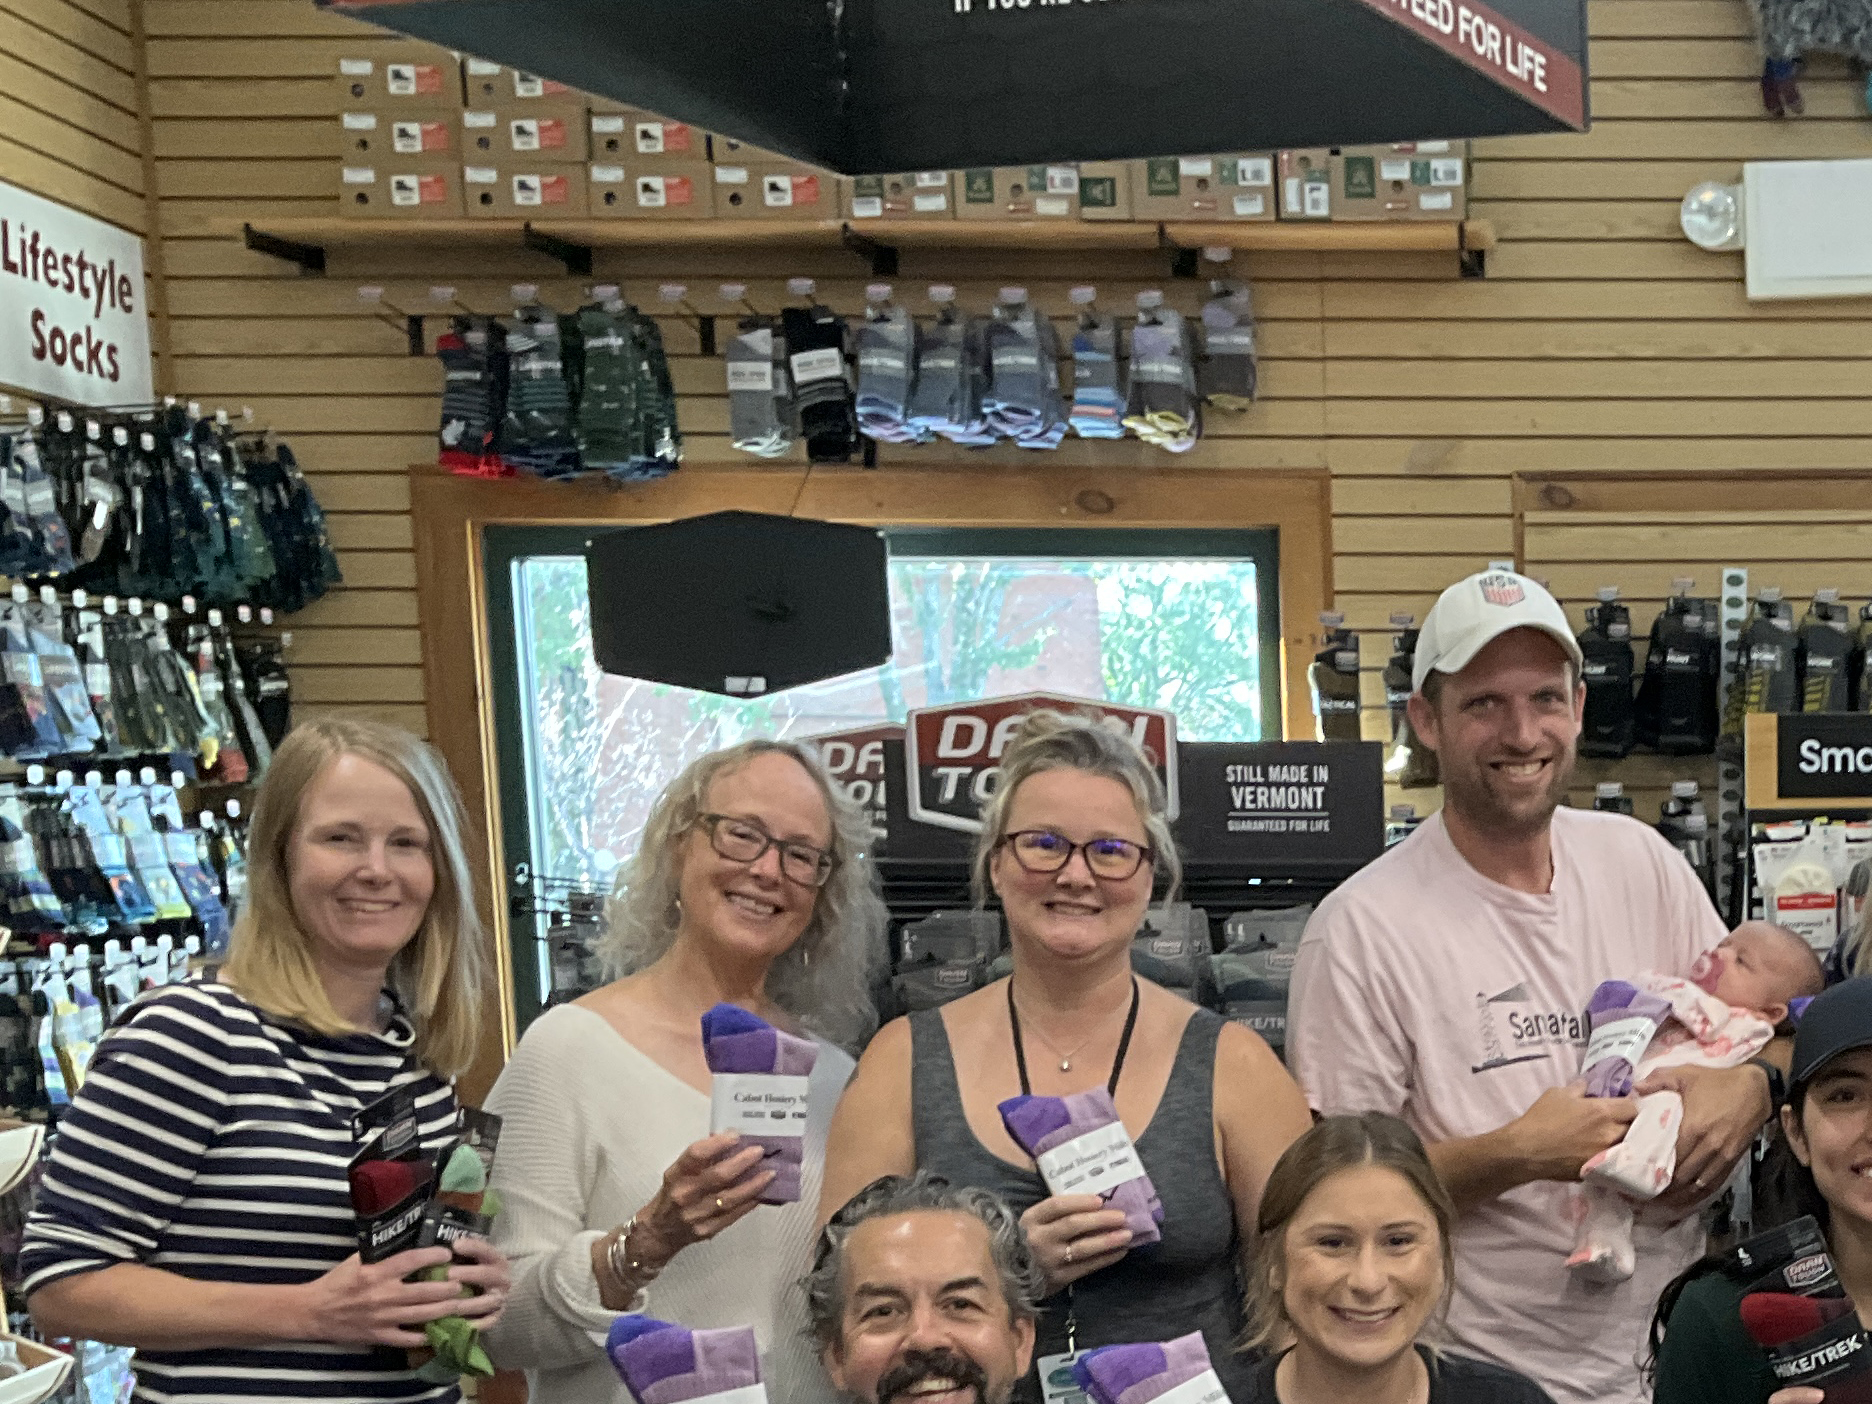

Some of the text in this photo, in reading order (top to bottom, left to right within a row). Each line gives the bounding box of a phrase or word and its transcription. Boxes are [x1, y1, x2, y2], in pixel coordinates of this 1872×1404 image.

[1458, 5, 1502, 66] FOR
[1505, 34, 1548, 93] LIFE
[1, 218, 134, 319] Lifestyle
[31, 307, 120, 383] Socks
[1226, 764, 1329, 783] STILL MADE IN
[1231, 785, 1325, 810] VERMONT
[1227, 819, 1330, 833] GUARANTEED FOR LIFE
